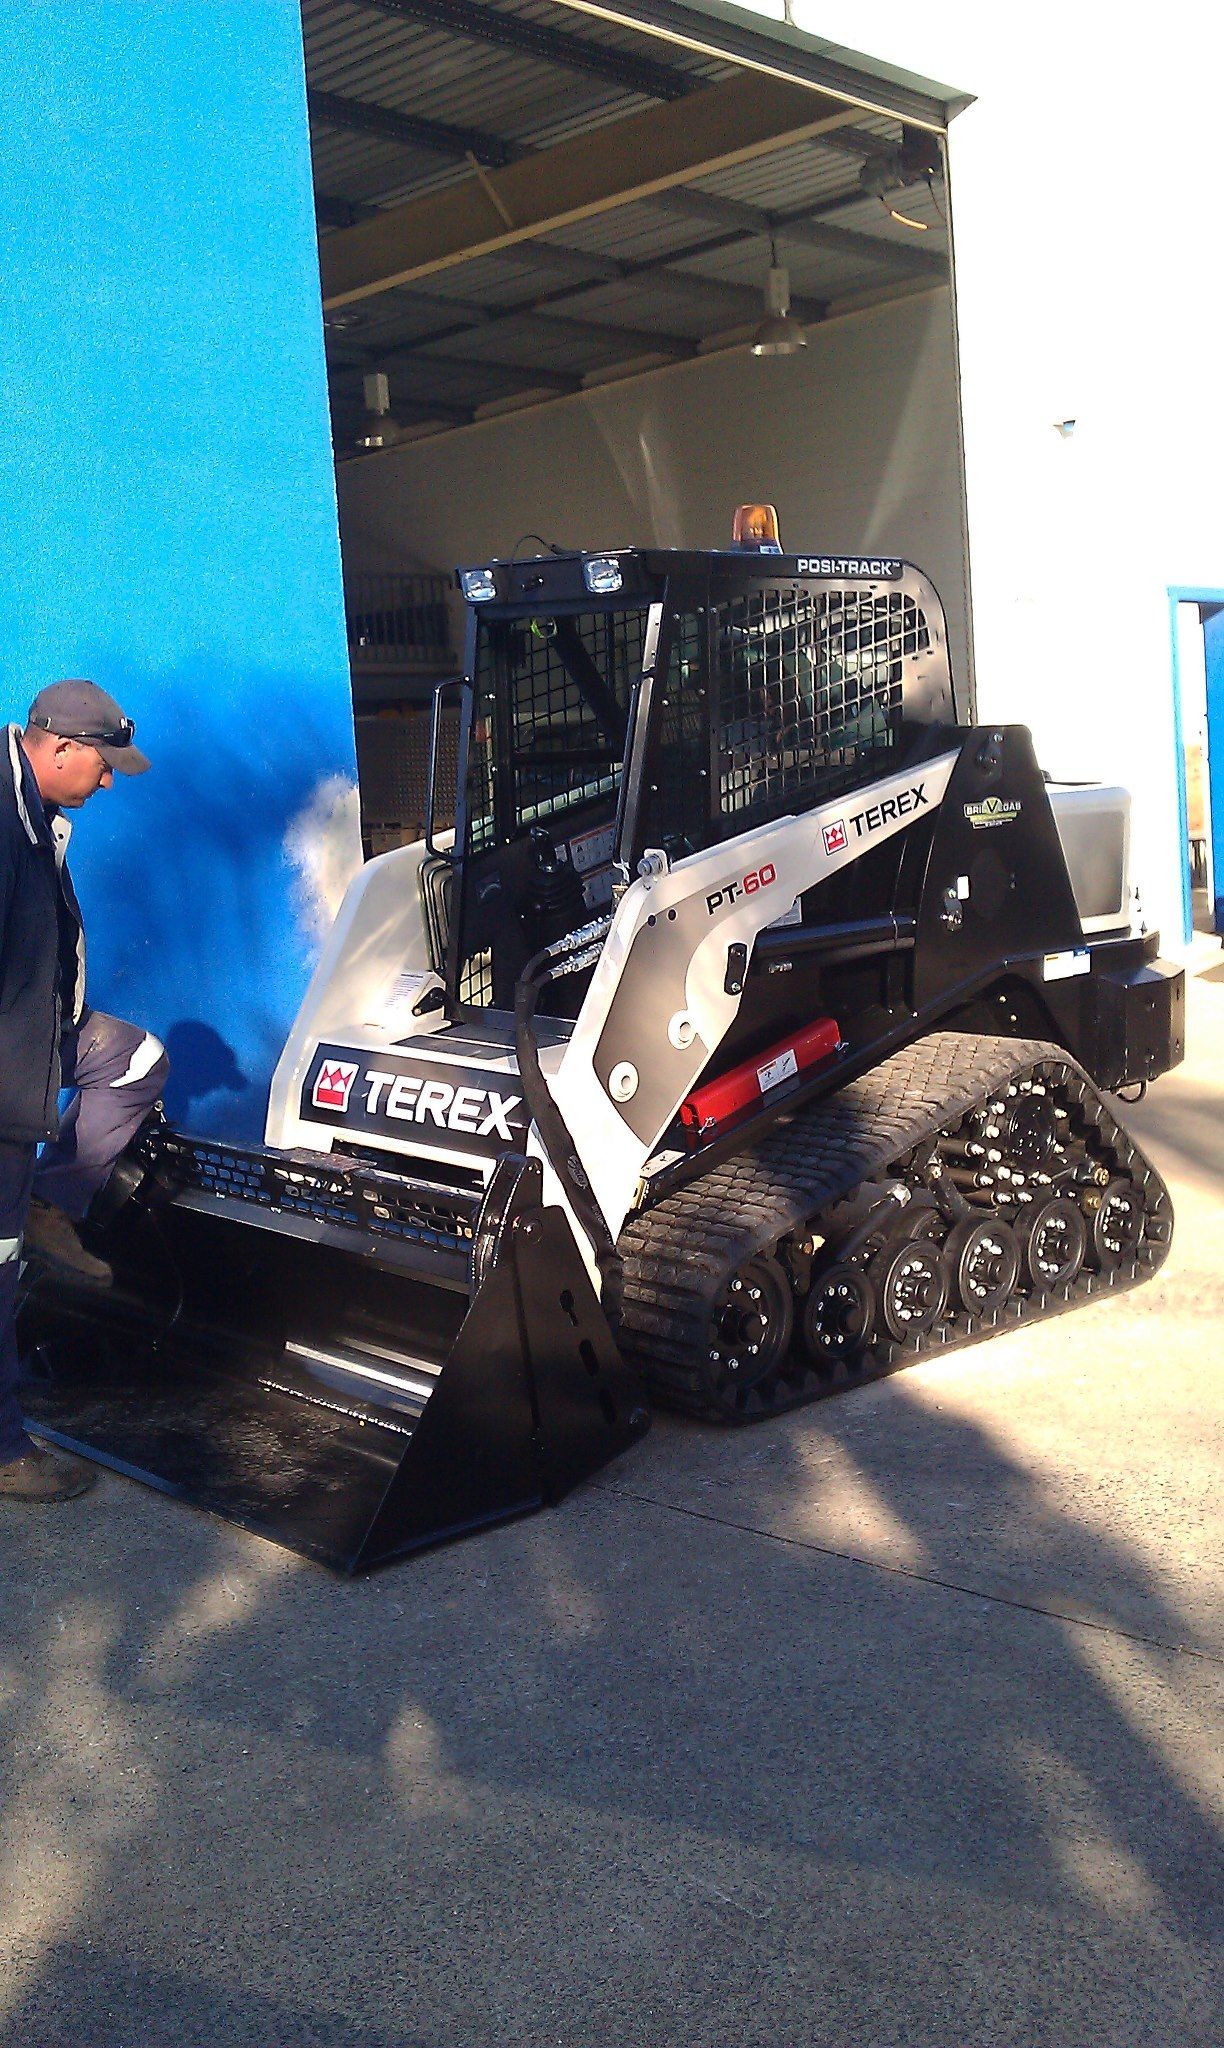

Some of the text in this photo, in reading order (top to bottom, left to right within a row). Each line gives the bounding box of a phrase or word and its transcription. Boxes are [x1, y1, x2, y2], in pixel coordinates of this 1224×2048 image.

[797, 558, 893, 575] POSI-TRACK
[850, 783, 929, 838] TEREX
[705, 863, 777, 916] PT-60
[364, 1069, 523, 1142] TEREX
